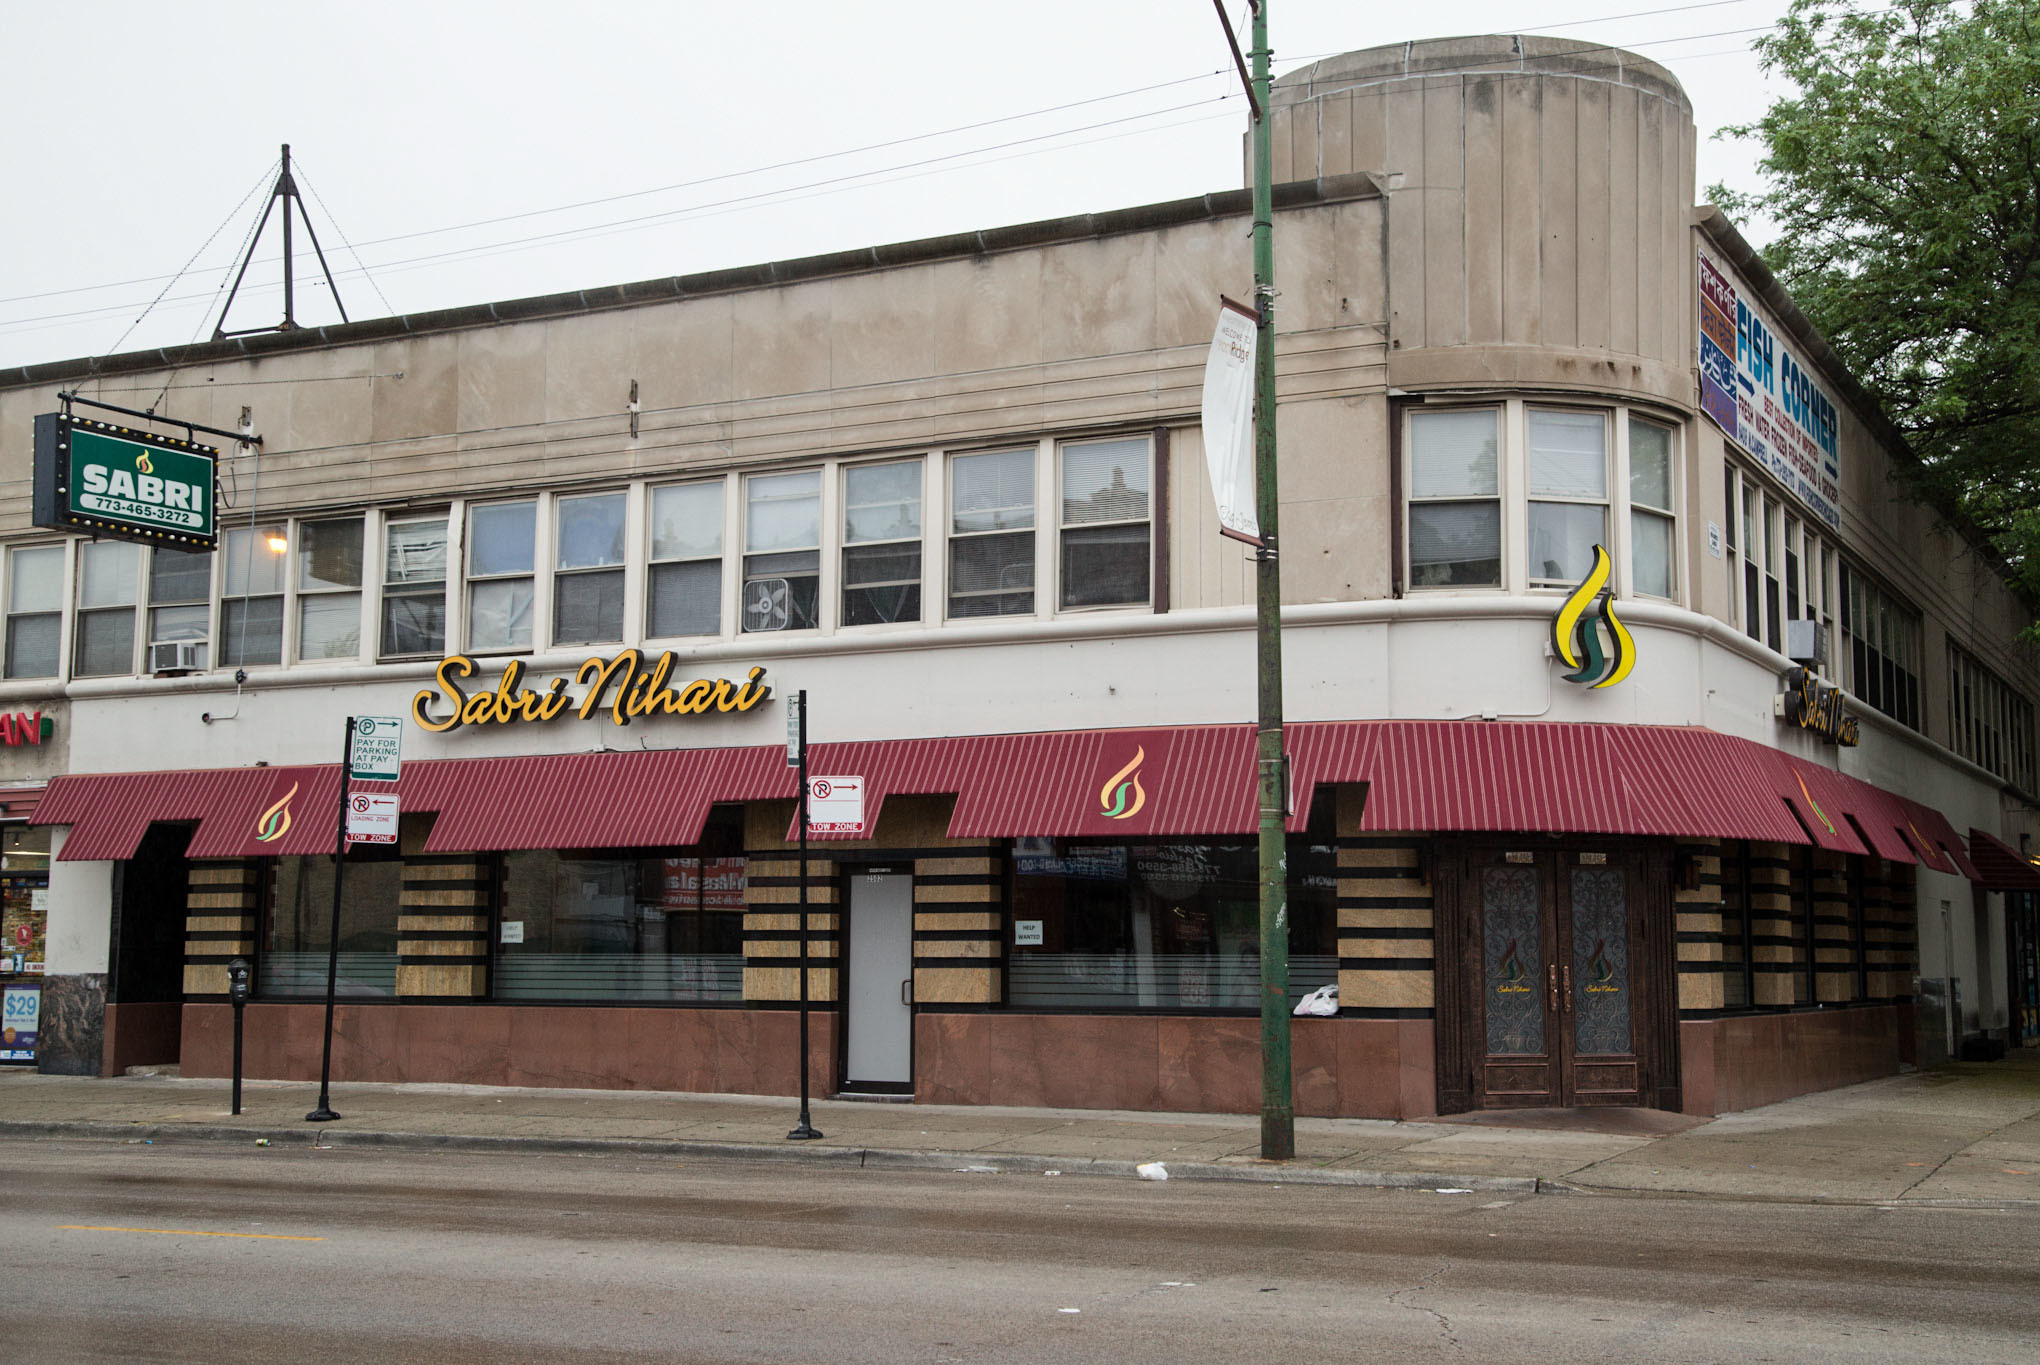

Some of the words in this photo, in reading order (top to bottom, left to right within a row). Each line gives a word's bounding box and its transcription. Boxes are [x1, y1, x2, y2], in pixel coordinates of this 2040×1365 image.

[1231, 341, 1250, 363] Ridge
[1737, 298, 1774, 396] FISH
[1782, 351, 1838, 463] CORNER
[1738, 394, 1754, 427] FRESH
[1755, 409, 1770, 441] WATER
[1771, 425, 1788, 459] FROZEN
[1763, 394, 1774, 419] BEST
[1774, 405, 1796, 441] COLLECTION
[1796, 427, 1801, 446] OF
[1802, 433, 1819, 464] IMPORTED
[82, 463, 203, 513] SABRI
[96, 497, 190, 524] 773-465-3272
[412, 654, 574, 733] Sabri
[576, 648, 772, 727] Nihari
[1797, 666, 1828, 731] Sabri
[356, 739, 375, 747] PAY
[378, 740, 396, 748] FOR
[356, 747, 398, 756] PARKING
[355, 762, 374, 770] BOX
[371, 755, 389, 763] PAY
[349, 833, 367, 841] TOW
[371, 834, 392, 842] ZONE
[835, 823, 858, 831] ZONE
[6, 993, 37, 1017] $29
